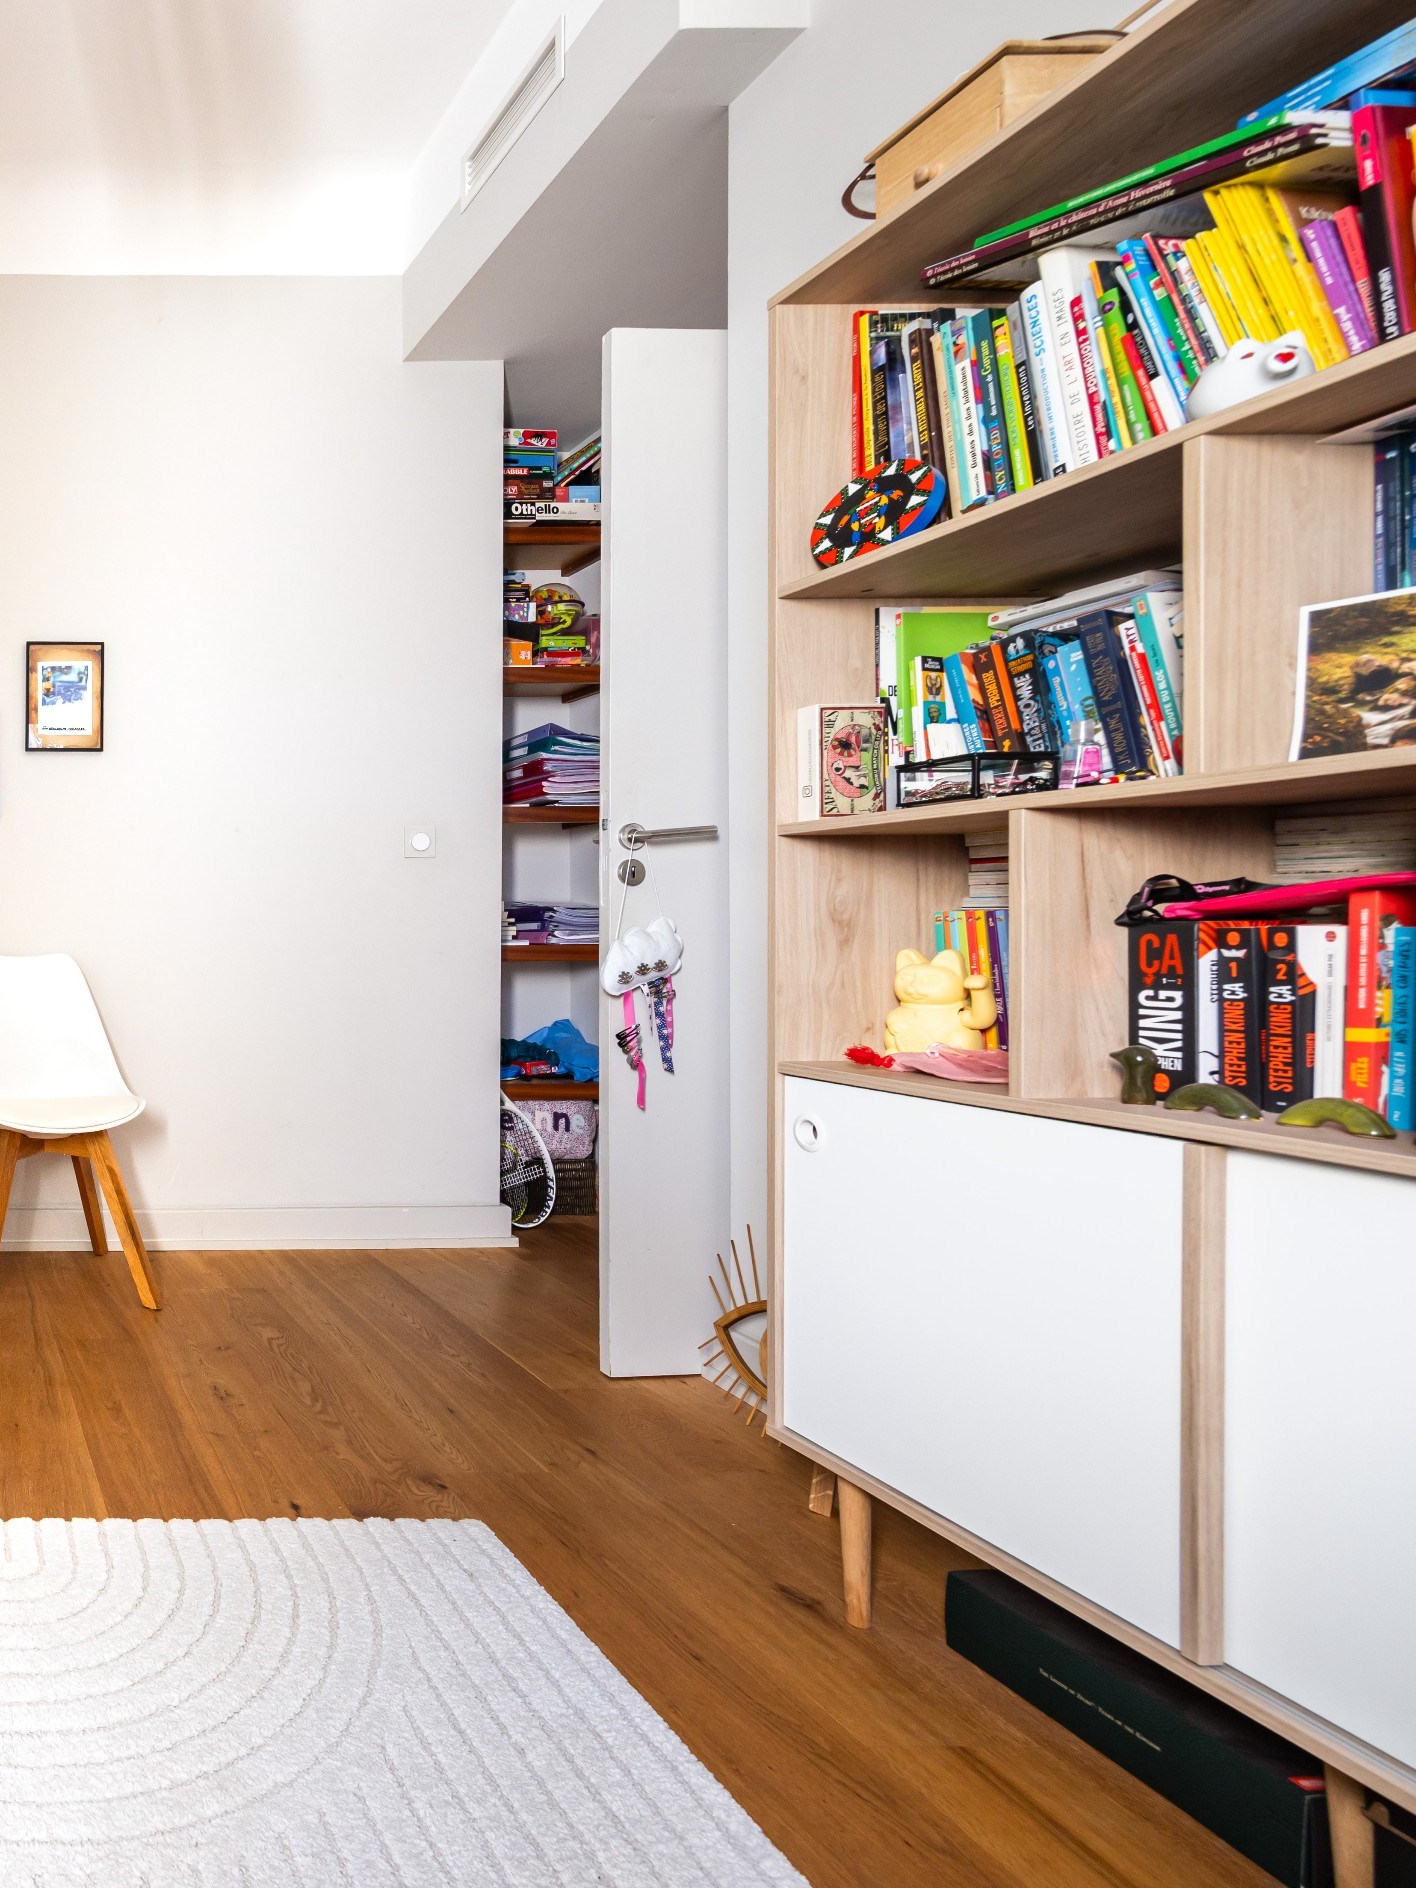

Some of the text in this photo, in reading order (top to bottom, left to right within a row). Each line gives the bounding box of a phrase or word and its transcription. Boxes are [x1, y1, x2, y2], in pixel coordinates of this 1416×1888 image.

[1378, 267, 1394, 300] humain
[1026, 294, 1046, 357] SCIENCES
[979, 339, 993, 375] Guyane
[1052, 287, 1090, 464] HISTOIRE DE L'ART EN IMAGES
[1080, 343, 1097, 394] POURQUOI
[874, 400, 886, 414] des
[1017, 365, 1032, 415] Inventions
[1040, 368, 1054, 424] INTRODUCTION
[919, 434, 929, 444] LES
[1026, 415, 1035, 430] Les
[987, 419, 1007, 499] ENCYCLOPÉDIE
[1048, 426, 1059, 463] PREMIÈRE
[511, 503, 559, 514] Othello
[1124, 626, 1138, 645] RTY
[1091, 655, 1112, 700] ANIMAUX
[1155, 669, 1168, 690] BLOC
[1161, 690, 1170, 702] DU
[982, 670, 1008, 737] TERRE PROMISE
[1014, 673, 1038, 730] BROWNE
[1164, 703, 1177, 728] ROUTE
[824, 711, 839, 751] MATCHES
[1107, 714, 1127, 752] ROWLING
[823, 777, 839, 813] SAFETY
[1138, 933, 1184, 986] ÇA
[1228, 961, 1237, 977] 1
[1275, 964, 1287, 980] 2
[1138, 989, 1183, 1058] KING
[1222, 982, 1248, 1086] STEPHEN KING ÇA
[1268, 985, 1296, 1092] STEPHEN KING ÇA
